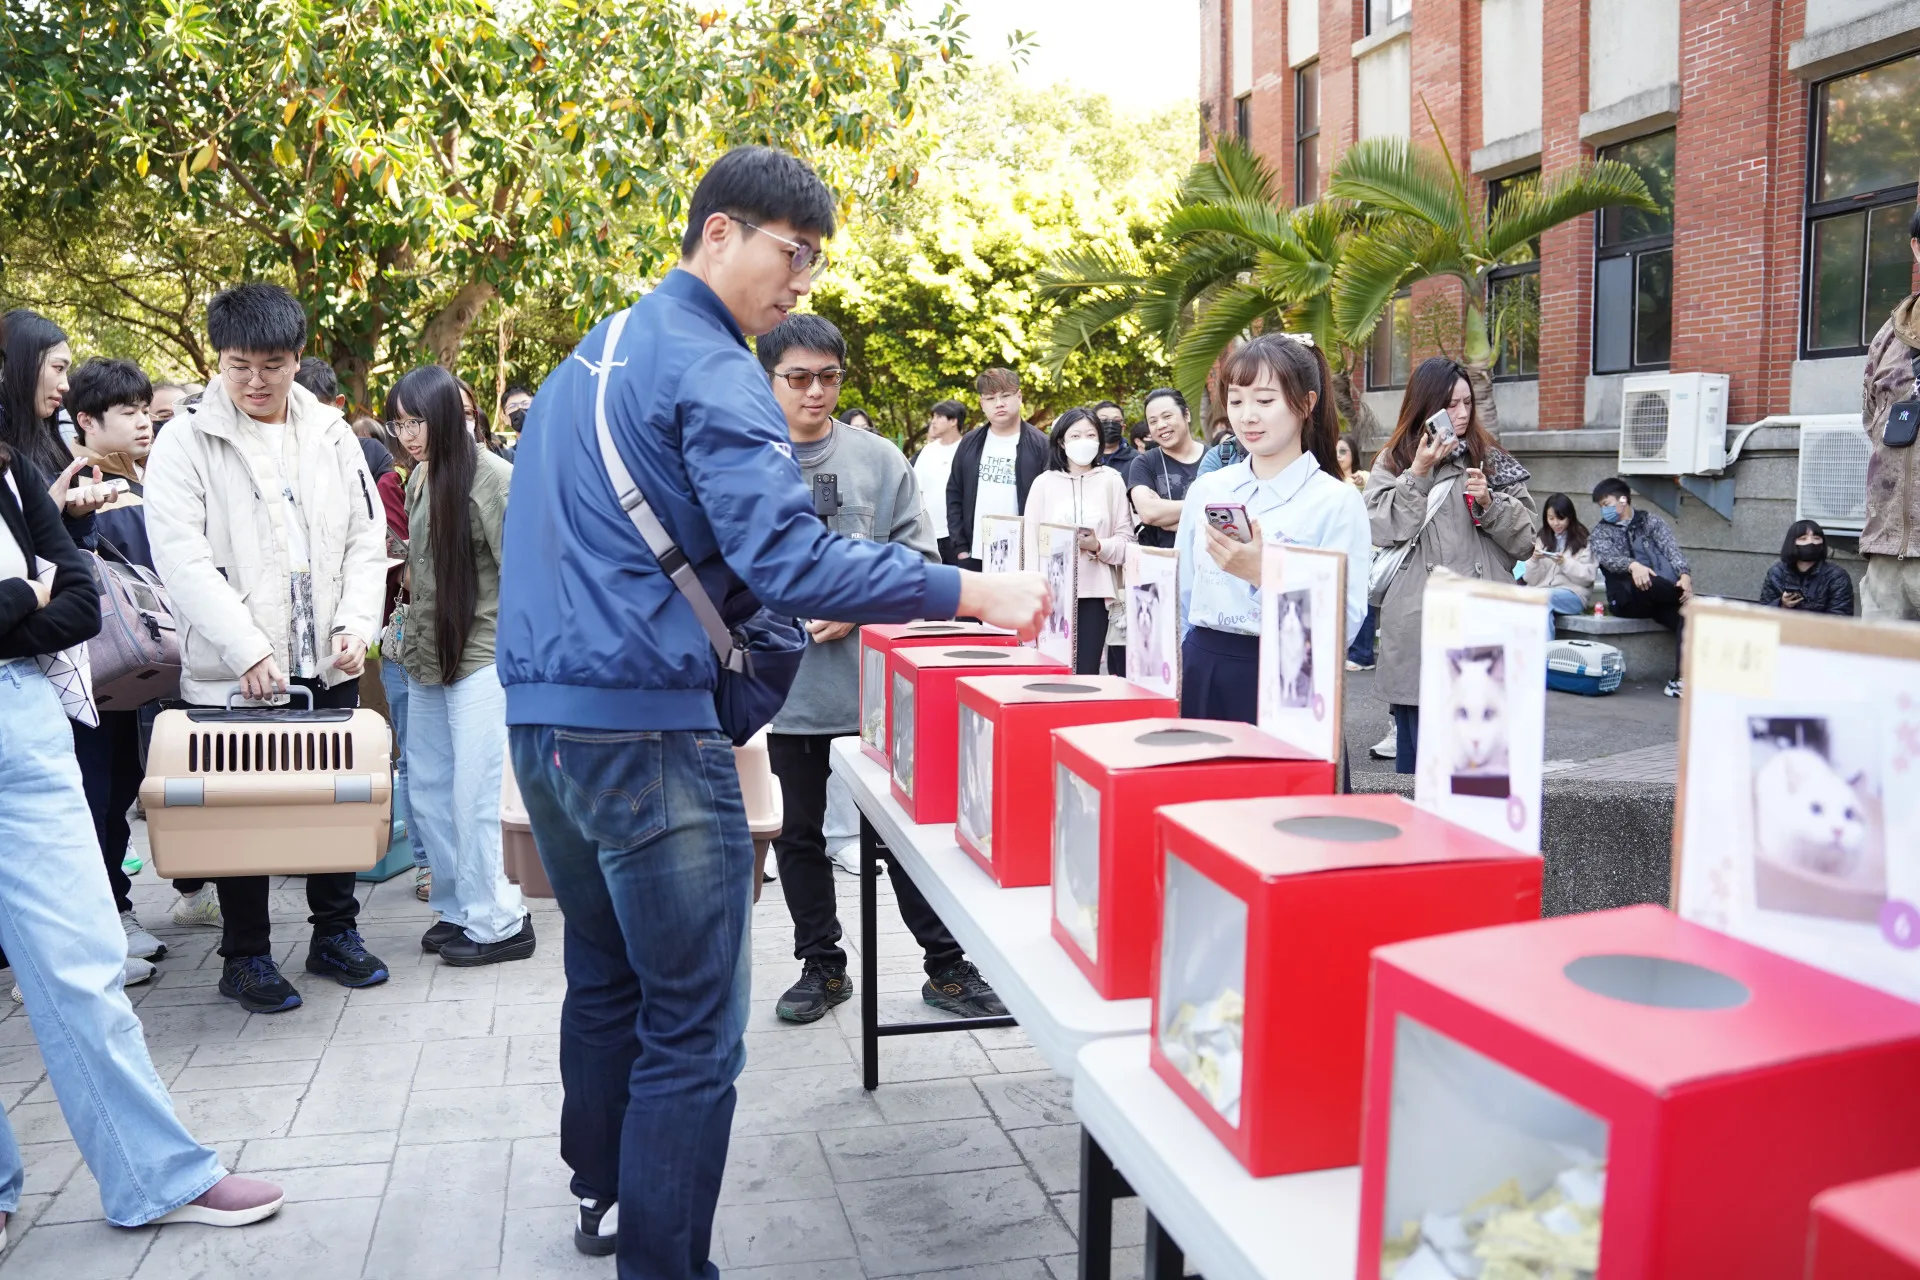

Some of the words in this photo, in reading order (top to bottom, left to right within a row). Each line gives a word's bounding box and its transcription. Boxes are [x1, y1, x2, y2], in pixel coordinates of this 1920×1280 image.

[987, 456, 1005, 466] THE
[979, 464, 1003, 474] ORTH
[1218, 612, 1246, 625] love
[1893, 912, 1911, 941] 6
